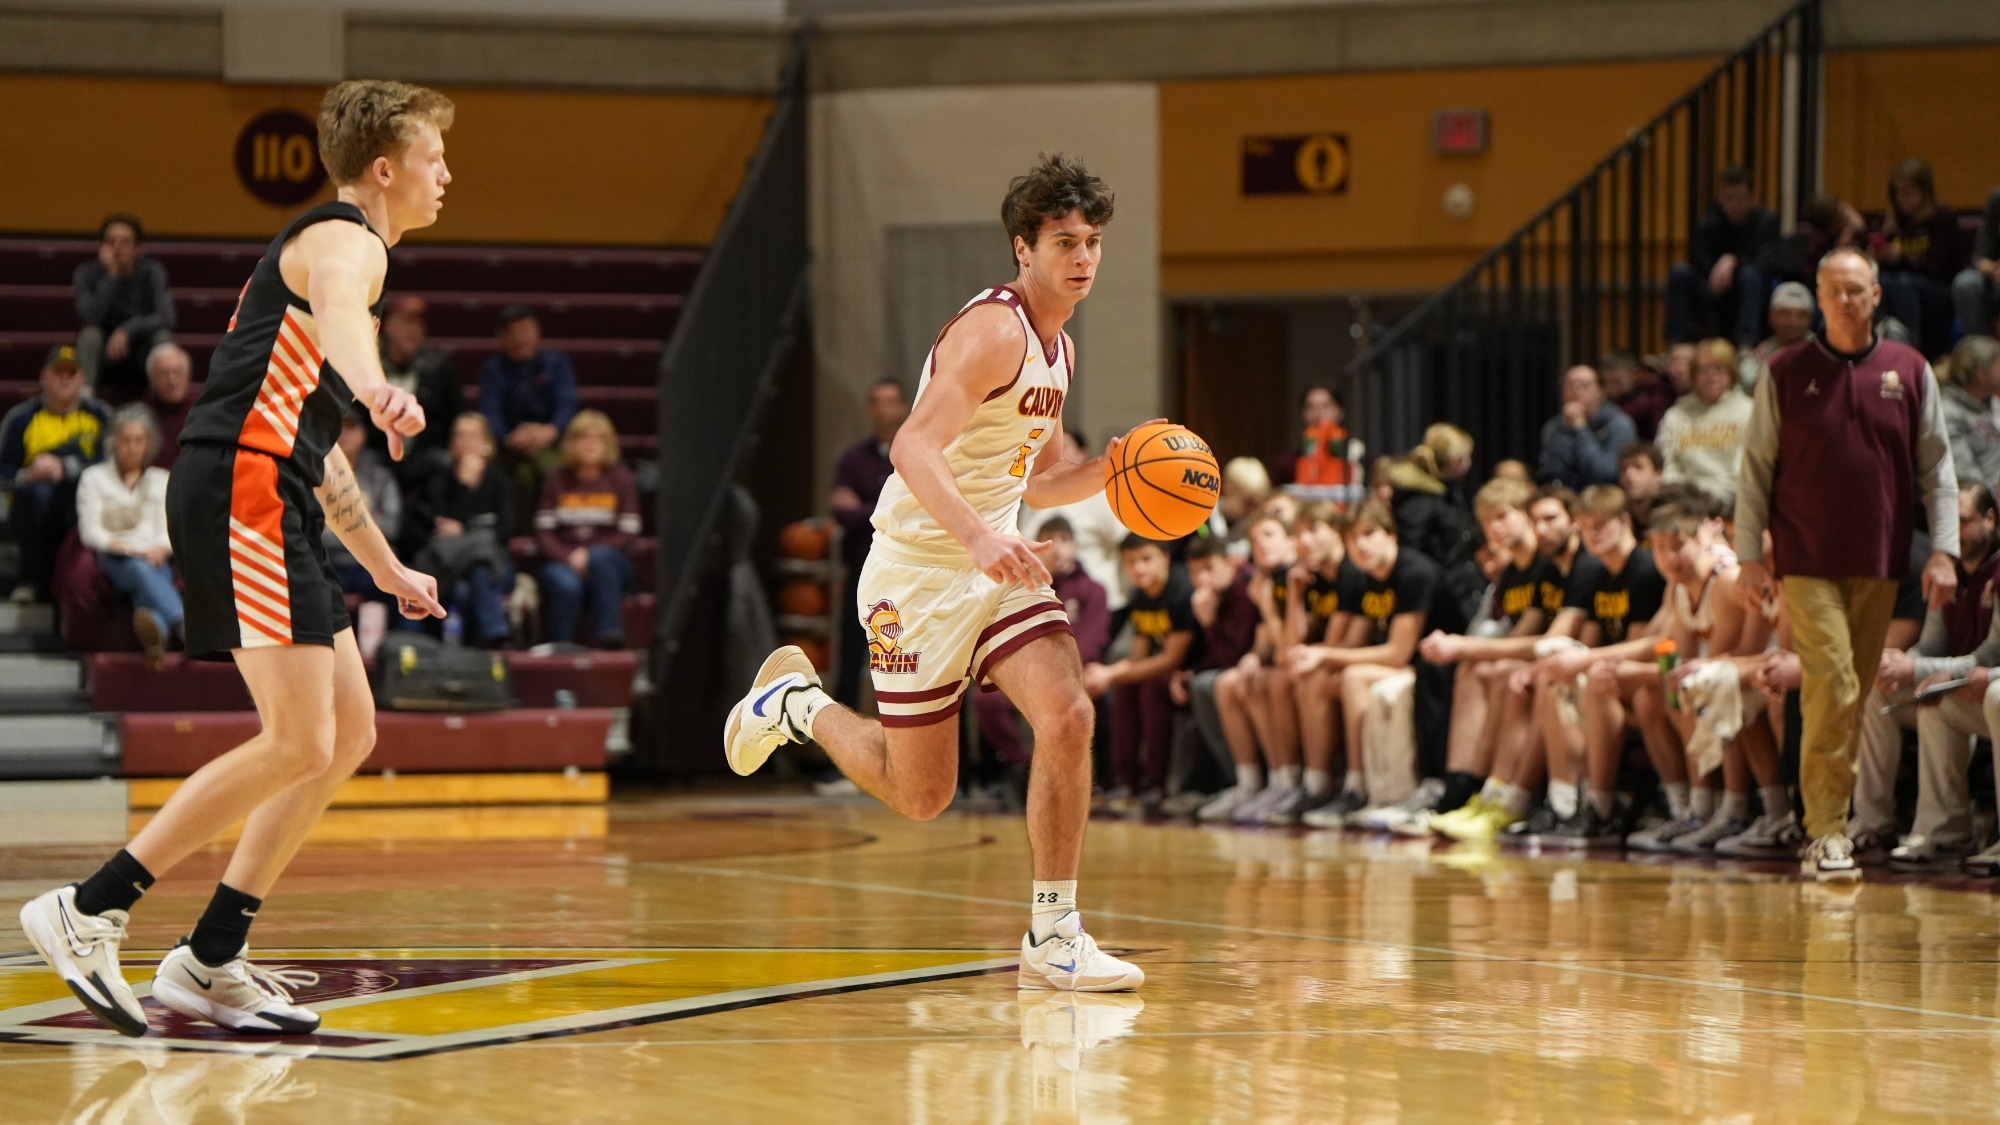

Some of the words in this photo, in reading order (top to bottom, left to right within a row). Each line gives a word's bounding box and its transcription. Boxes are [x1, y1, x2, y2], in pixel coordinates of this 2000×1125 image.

[253, 133, 312, 181] 110
[1162, 434, 1213, 456] Wils
[1181, 467, 1219, 494] NCAA
[870, 652, 921, 674] ALVIN
[1036, 892, 1059, 903] 23
